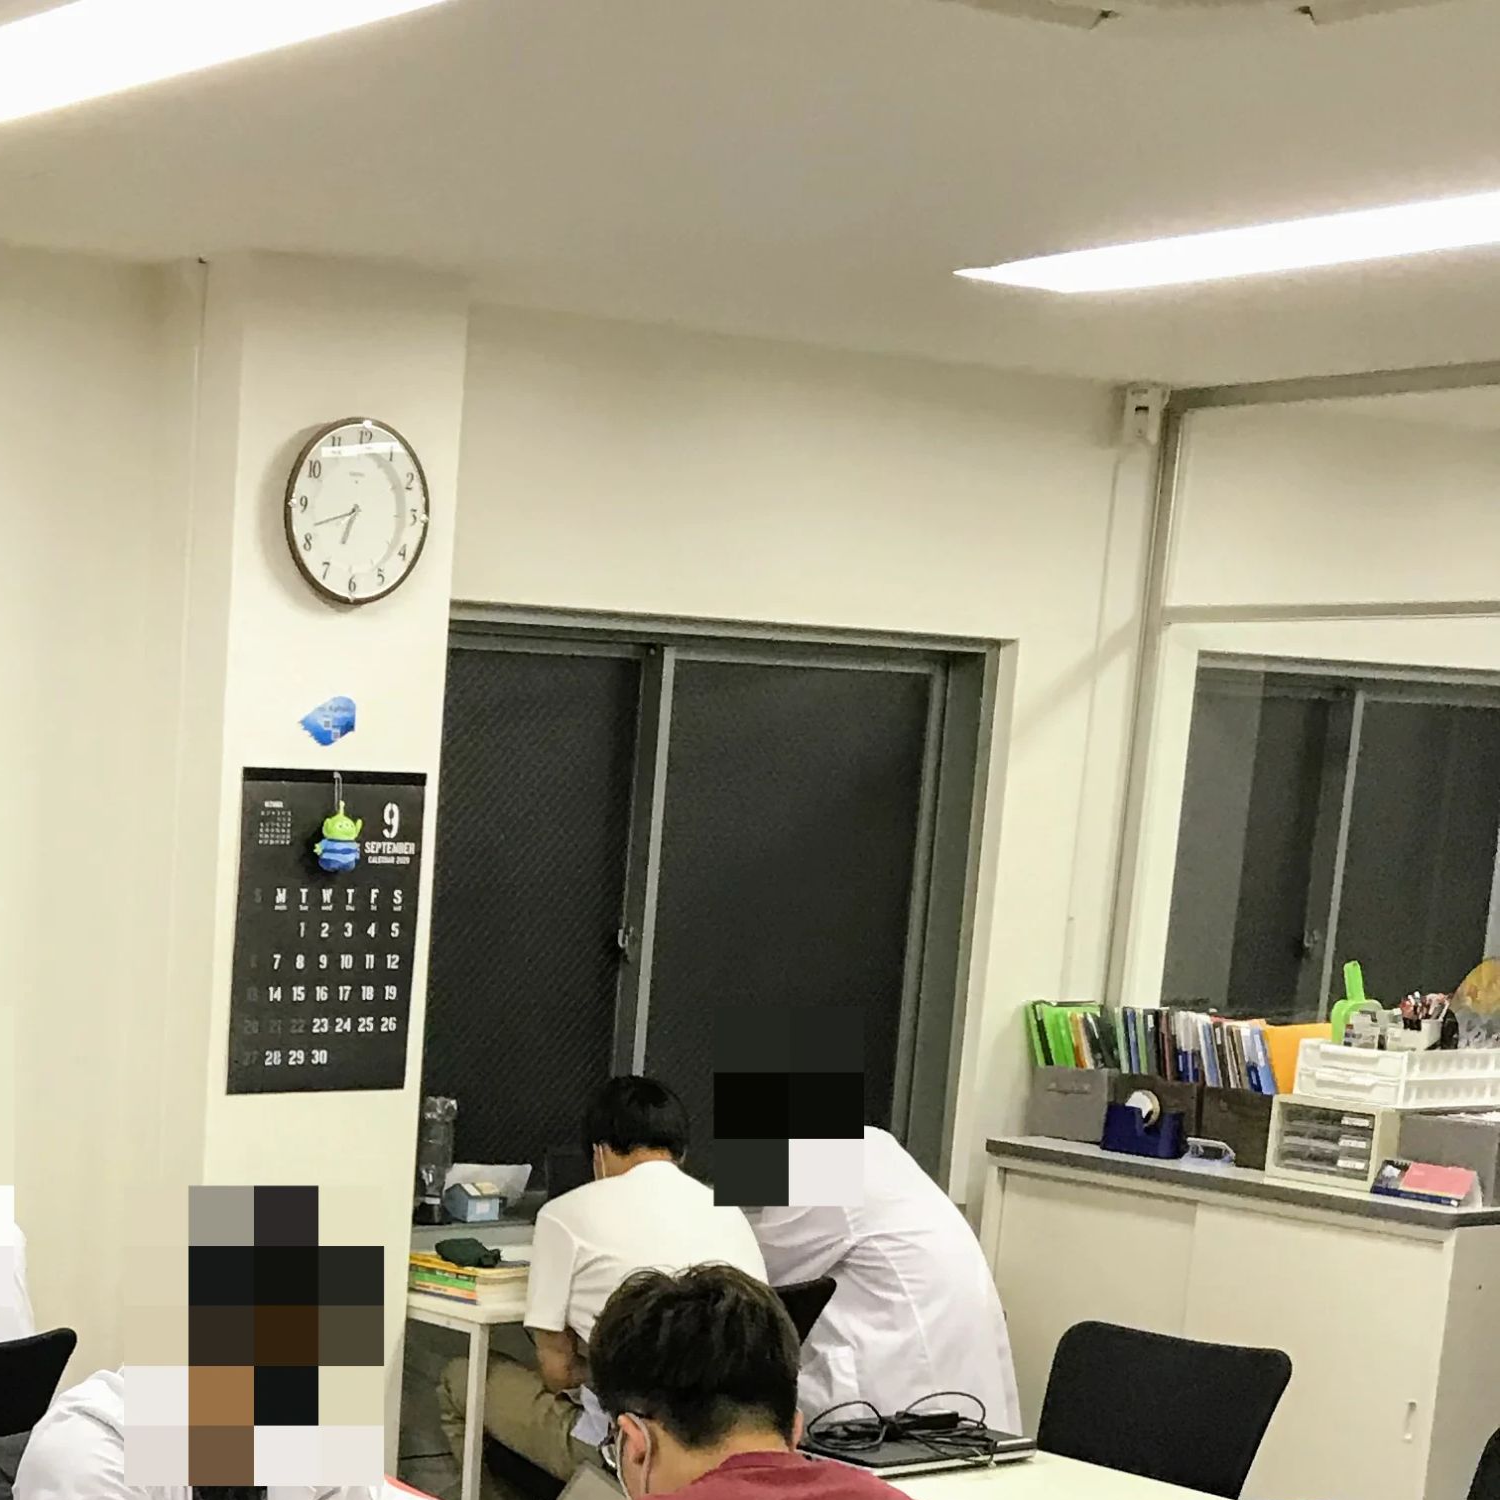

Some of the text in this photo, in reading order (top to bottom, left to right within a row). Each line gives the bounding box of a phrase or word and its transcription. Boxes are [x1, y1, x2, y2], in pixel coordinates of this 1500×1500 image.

[331, 436, 342, 455] 11
[307, 459, 322, 479] 10
[405, 472, 414, 490] 2
[300, 495, 308, 514] 9
[303, 532, 312, 551] 8
[398, 544, 406, 561] 4
[322, 561, 330, 580] 7
[376, 567, 385, 586] 5
[348, 574, 356, 592] 6
[382, 802, 400, 838] 9
[364, 841, 415, 855] SEPTEMBER
[276, 888, 287, 904] M
[300, 888, 308, 904] T
[322, 888, 333, 904] W
[347, 889, 355, 904] T
[370, 889, 379, 904] F
[393, 889, 403, 905] S
[300, 922, 400, 938] 1 2 3 4 5
[273, 954, 281, 970] 7
[296, 954, 305, 970] 8
[319, 954, 328, 970] 9
[340, 954, 353, 970] 10
[365, 954, 374, 970] 11
[386, 954, 400, 970] 12
[268, 986, 282, 1001] 14
[292, 986, 305, 1001] 15
[315, 986, 329, 1001] 16
[338, 986, 352, 1001] 17
[361, 986, 374, 1001] 18
[384, 985, 397, 1000] 19
[290, 1019, 305, 1034] 22
[312, 1018, 329, 1033] 23
[335, 1017, 352, 1033] 24
[357, 1017, 374, 1032] 25
[380, 1017, 397, 1032] 26
[264, 1050, 282, 1066] 28
[288, 1050, 305, 1065] 29
[311, 1049, 328, 1064] 30
